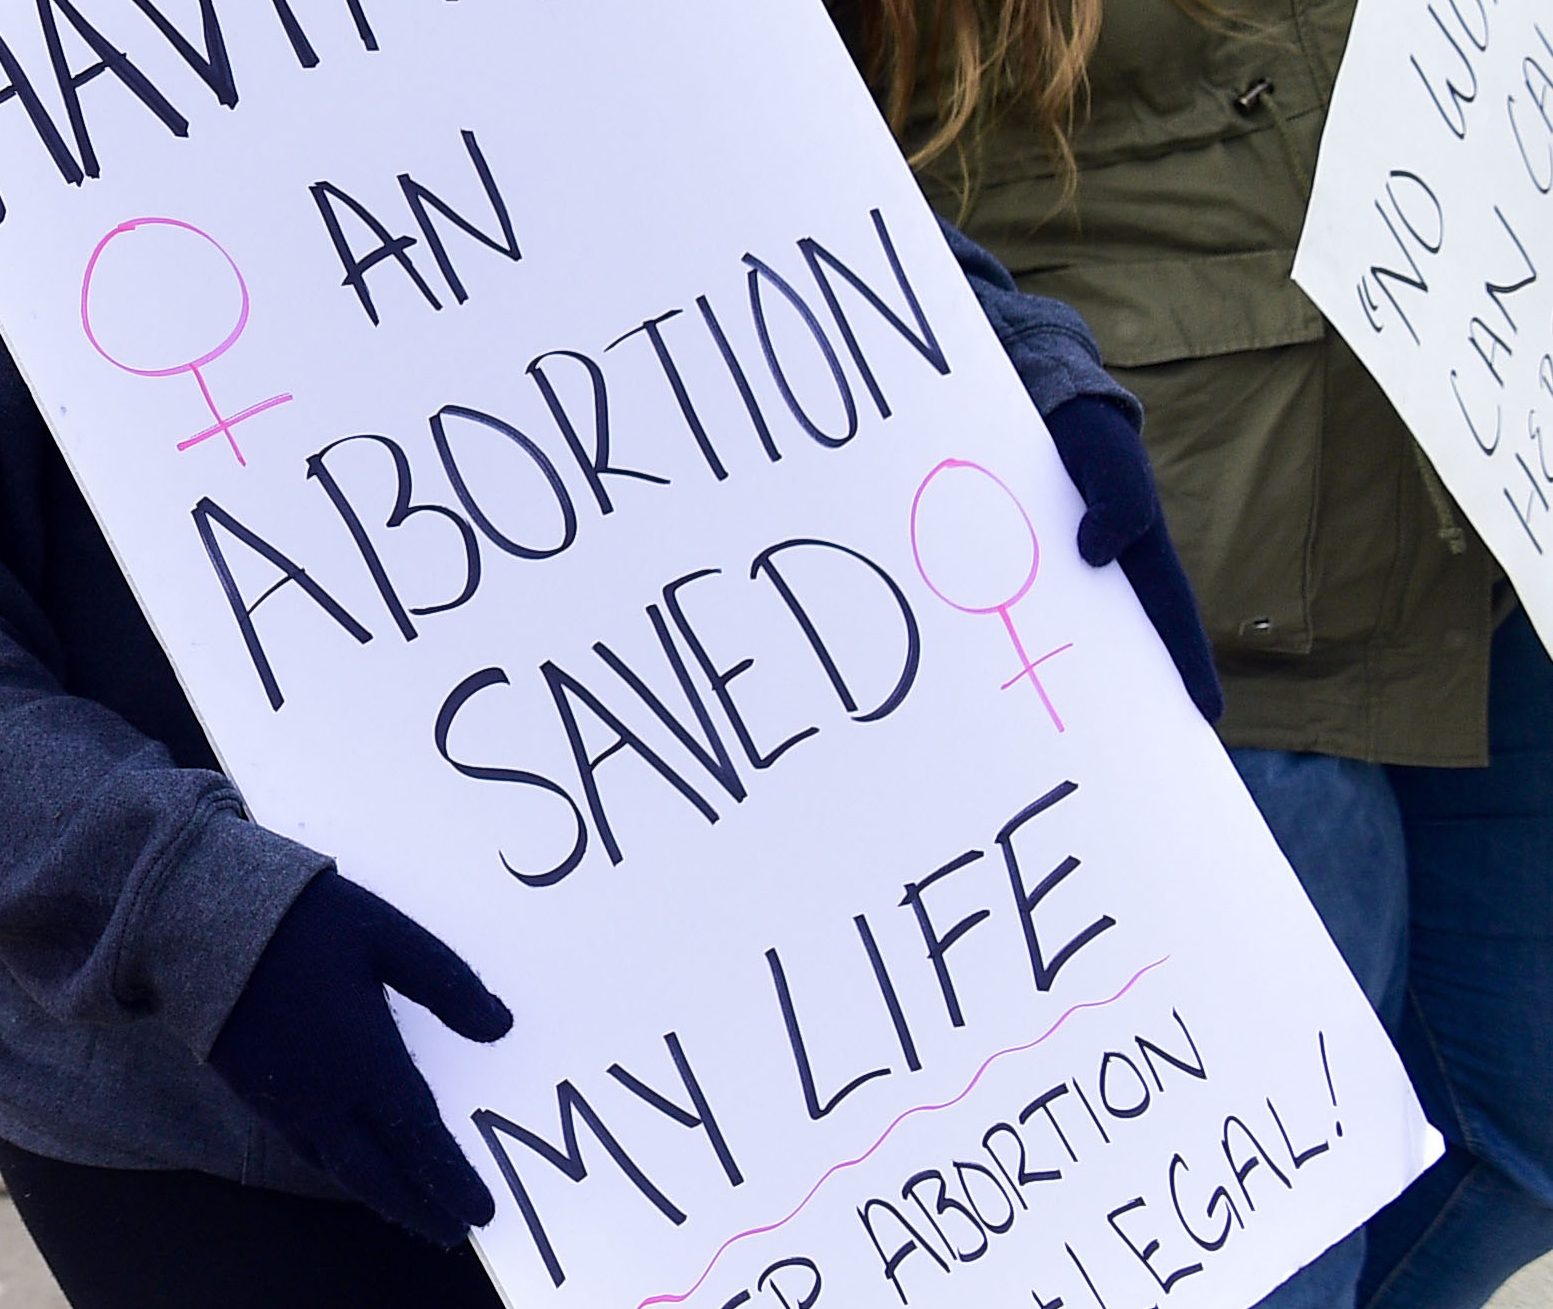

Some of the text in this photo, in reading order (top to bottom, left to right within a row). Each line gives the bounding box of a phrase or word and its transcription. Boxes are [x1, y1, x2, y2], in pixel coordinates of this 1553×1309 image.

[306, 129, 523, 327] AN
[1451, 205, 1537, 456] CAN
[191, 206, 952, 711] ABORTION
[432, 535, 921, 888] SAVED
[467, 778, 1118, 1289] MY LIFE
[855, 1007, 1208, 1306] ABORTION
[1064, 1030, 1344, 1309] LEGAL!
